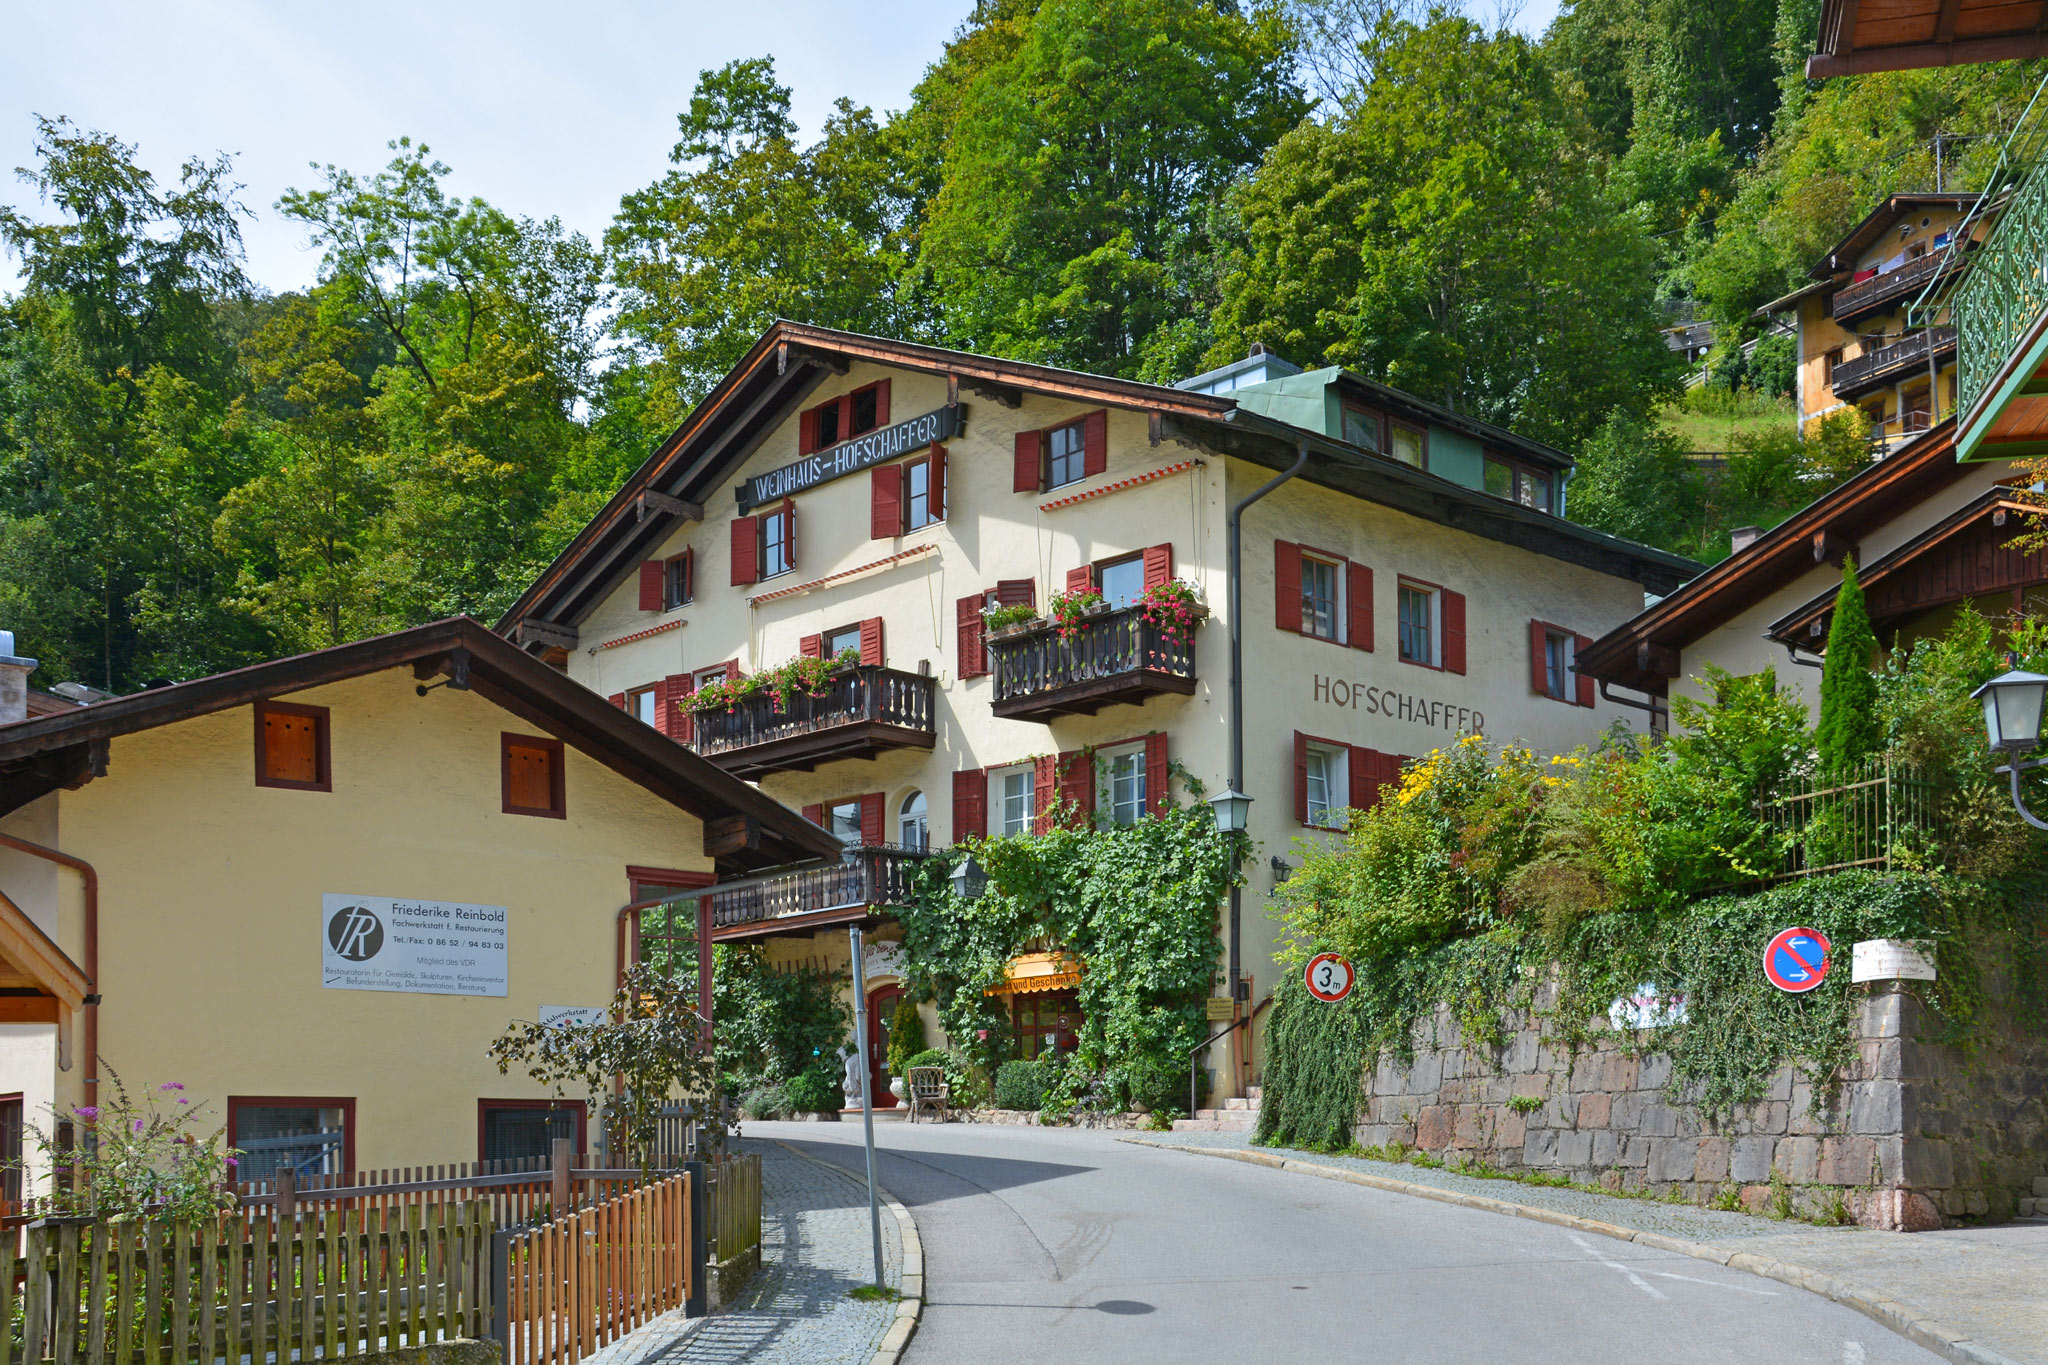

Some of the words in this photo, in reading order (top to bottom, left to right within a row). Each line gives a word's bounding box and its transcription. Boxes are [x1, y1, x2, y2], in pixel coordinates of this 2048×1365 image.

[1314, 674, 1485, 736] HOFSCHAFFER
[392, 903, 450, 918] Friederike
[455, 908, 504, 922] Reinbold
[392, 919, 444, 930] Fachwerkstatt
[446, 923, 452, 931] f.
[455, 924, 505, 936] Restaurierung
[393, 936, 425, 945] Tel./Fax:
[416, 957, 444, 967] Mitglied
[445, 959, 458, 967] des
[325, 967, 371, 977] Restauratorin
[373, 969, 383, 977] für
[385, 970, 417, 979] Gemälde,
[420, 972, 454, 981] Skulpturen,
[457, 974, 505, 983] Kircheninventar
[1014, 979, 1027, 990] und
[1030, 975, 1076, 988] Geschenke
[1319, 966, 1333, 988] 3
[1333, 981, 1341, 990] m
[346, 977, 403, 988] Befunderstellung,
[405, 980, 456, 990] Dokumentation,
[458, 983, 486, 992] Beratung
